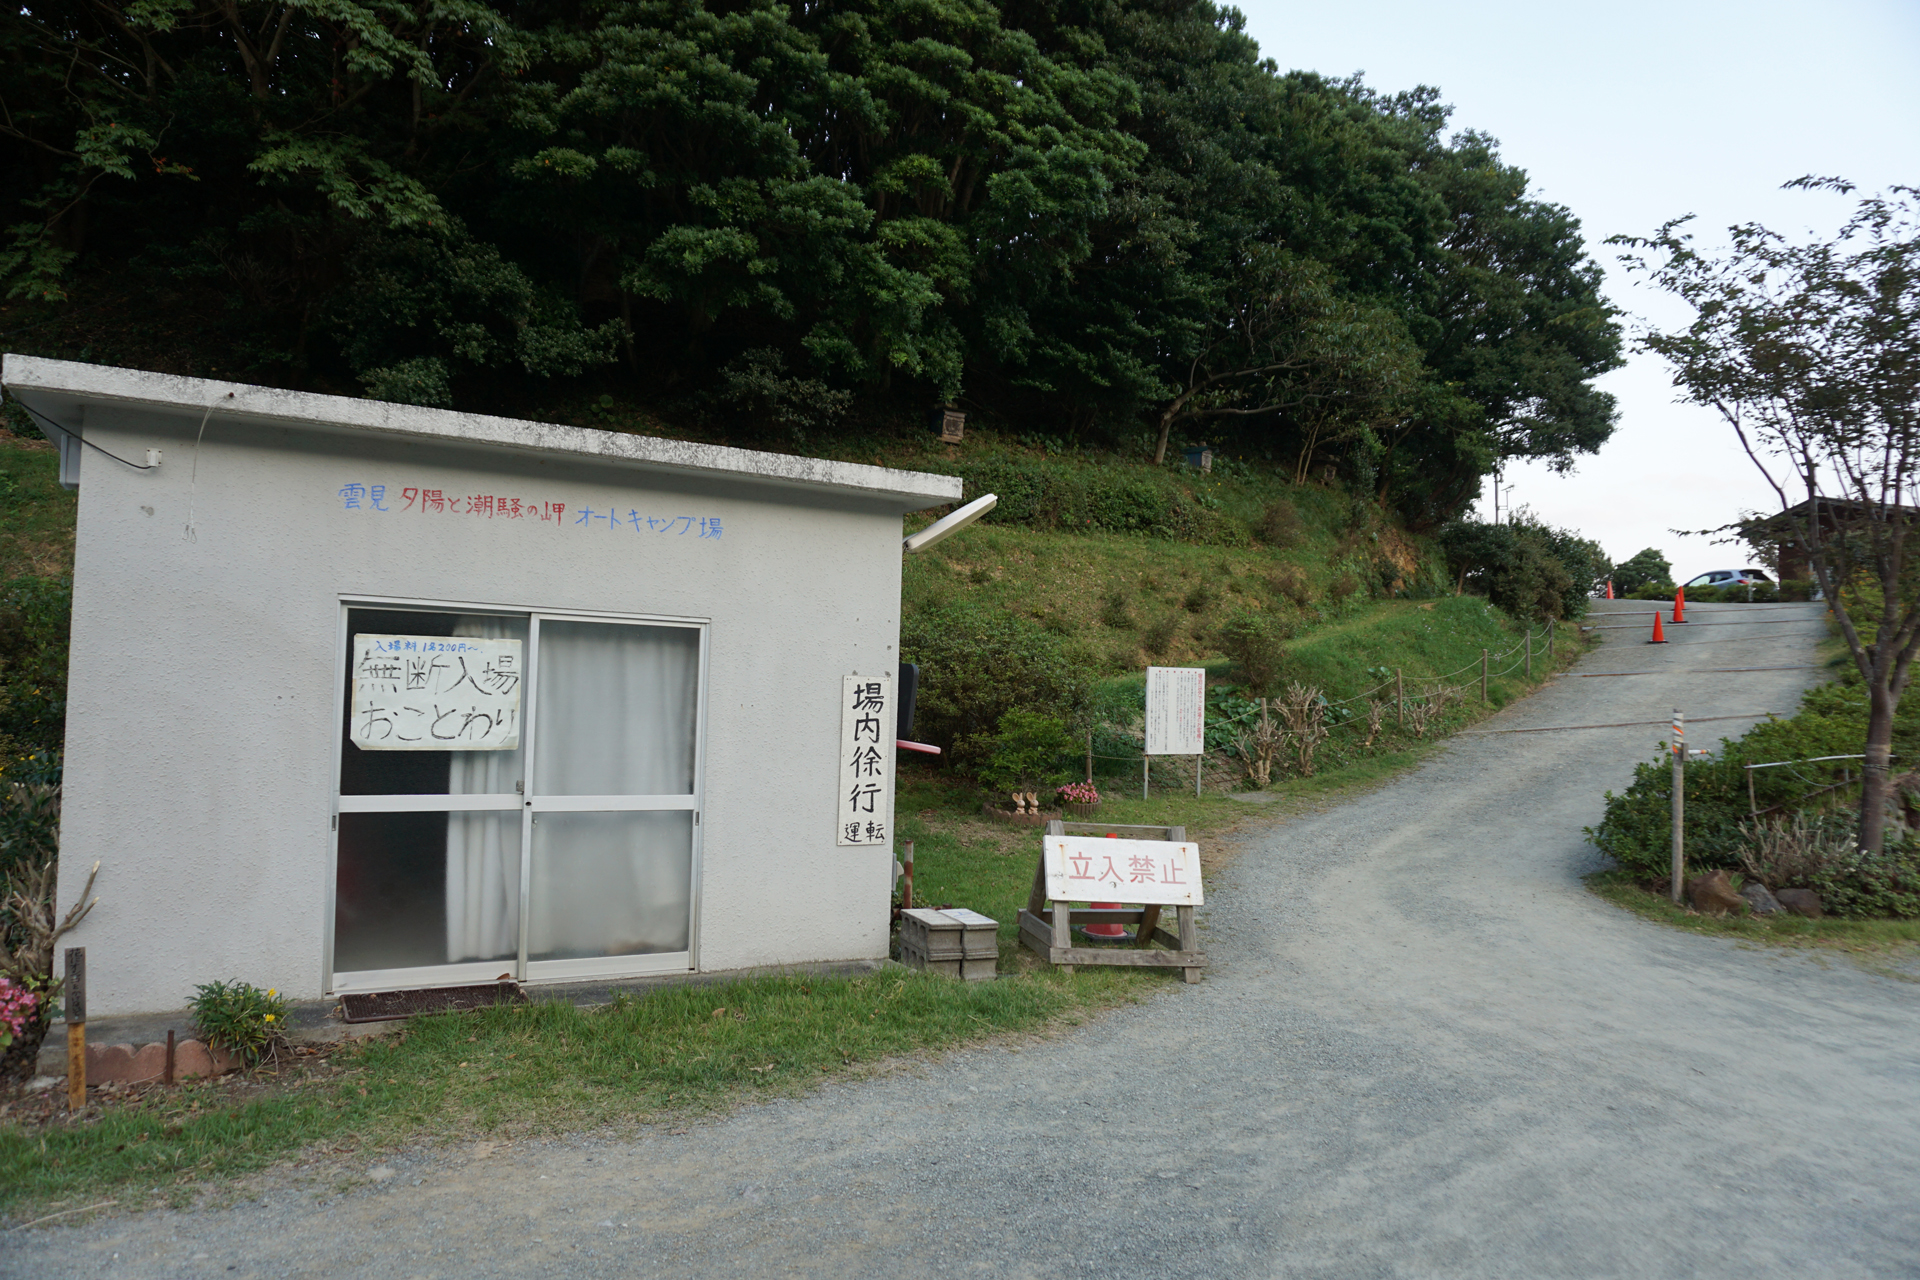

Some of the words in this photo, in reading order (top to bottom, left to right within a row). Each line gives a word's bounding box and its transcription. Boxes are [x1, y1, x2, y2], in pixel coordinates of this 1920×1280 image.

[338, 483, 390, 511] 雲見
[399, 487, 566, 527] 夕陽と潮騒の岬
[574, 505, 724, 540] オートキャンプ場
[358, 649, 519, 696] 無断入場
[359, 701, 515, 744] おことわり
[849, 682, 885, 813] 場内徐行
[844, 820, 885, 843] 運転
[1068, 851, 1187, 885] 立入禁止
